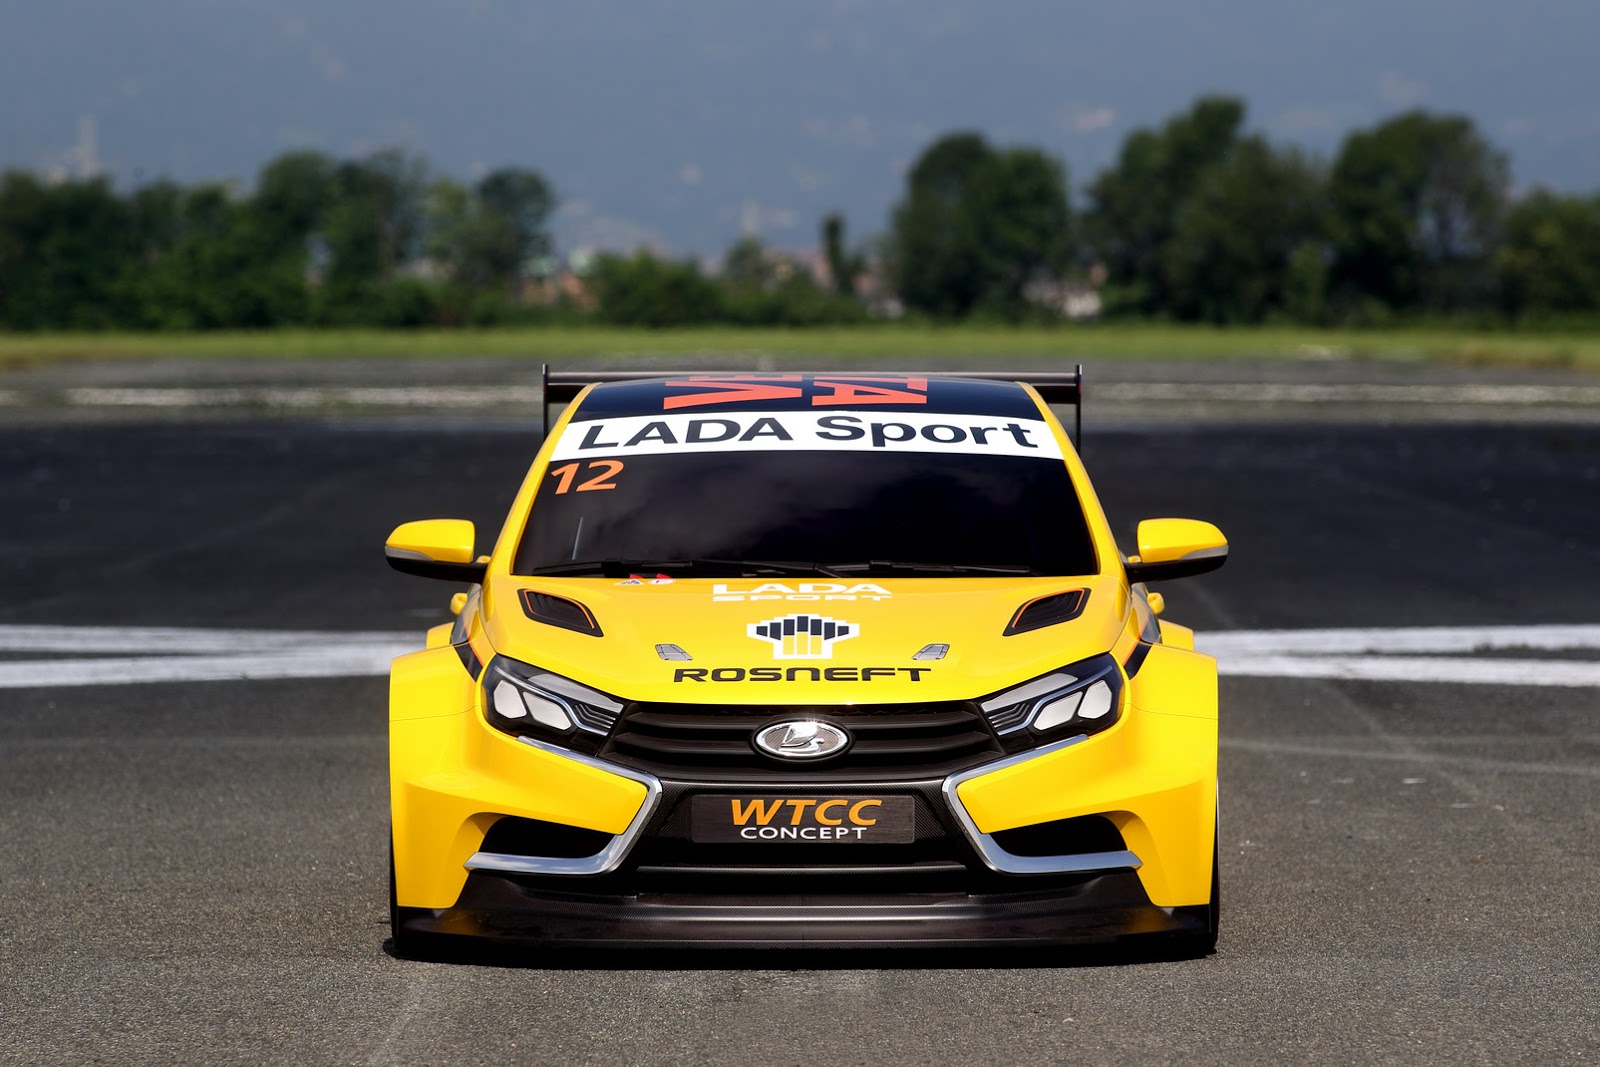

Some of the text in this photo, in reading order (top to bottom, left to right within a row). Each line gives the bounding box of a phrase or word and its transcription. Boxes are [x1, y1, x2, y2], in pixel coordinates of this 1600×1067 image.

[579, 416, 1038, 449] LADA Sport
[551, 460, 624, 495] 12
[712, 584, 892, 594] LADA
[673, 667, 931, 682] ROSNEFT
[731, 799, 882, 826] WTCC
[741, 827, 867, 839] CONCEPT
